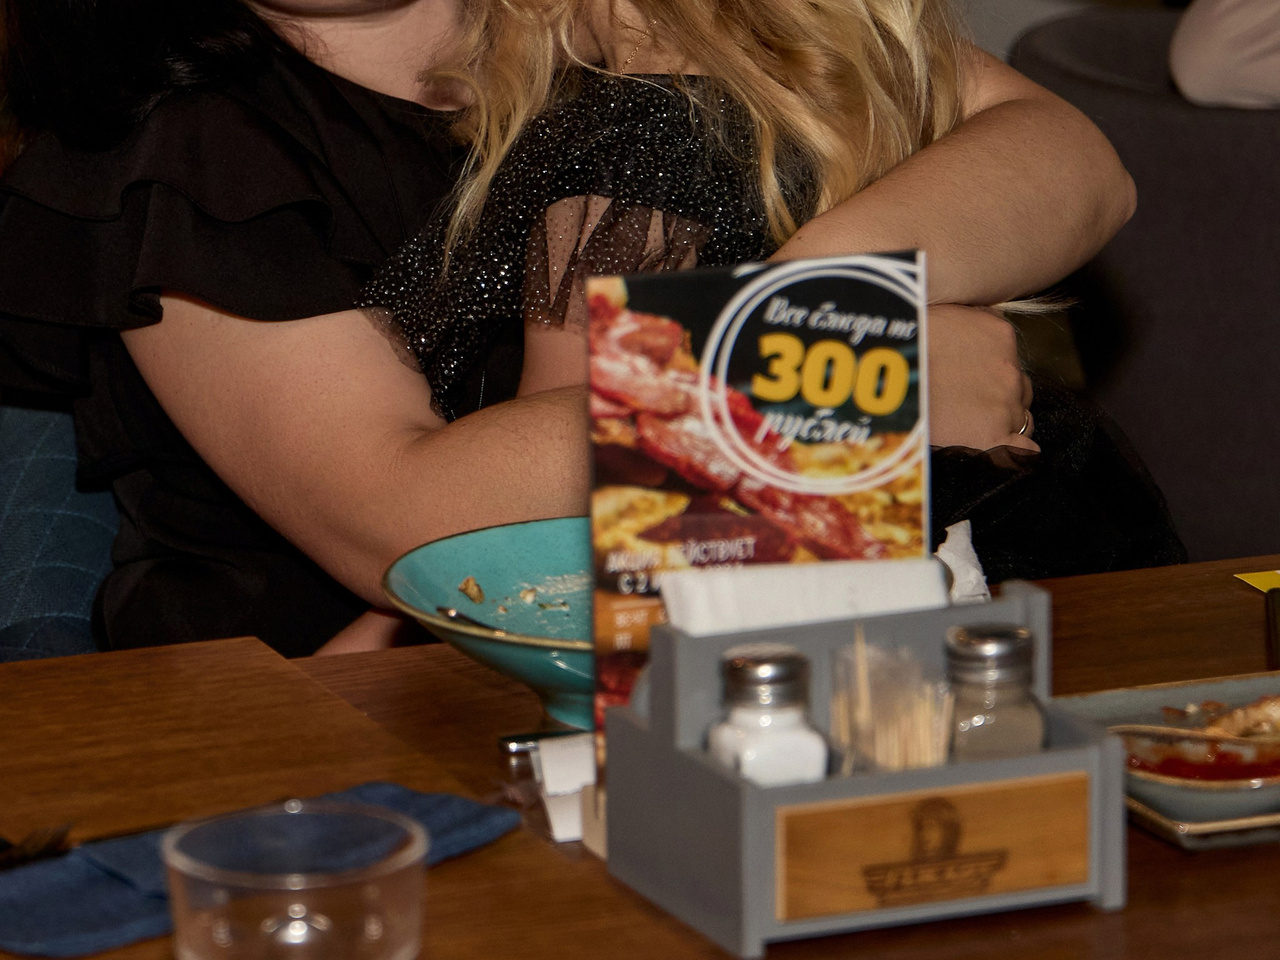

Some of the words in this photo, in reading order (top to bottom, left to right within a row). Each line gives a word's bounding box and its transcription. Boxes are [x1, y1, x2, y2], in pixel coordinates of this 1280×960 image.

[764, 296, 807, 326] Все
[751, 331, 910, 418] 300
[754, 408, 871, 452] рублей
